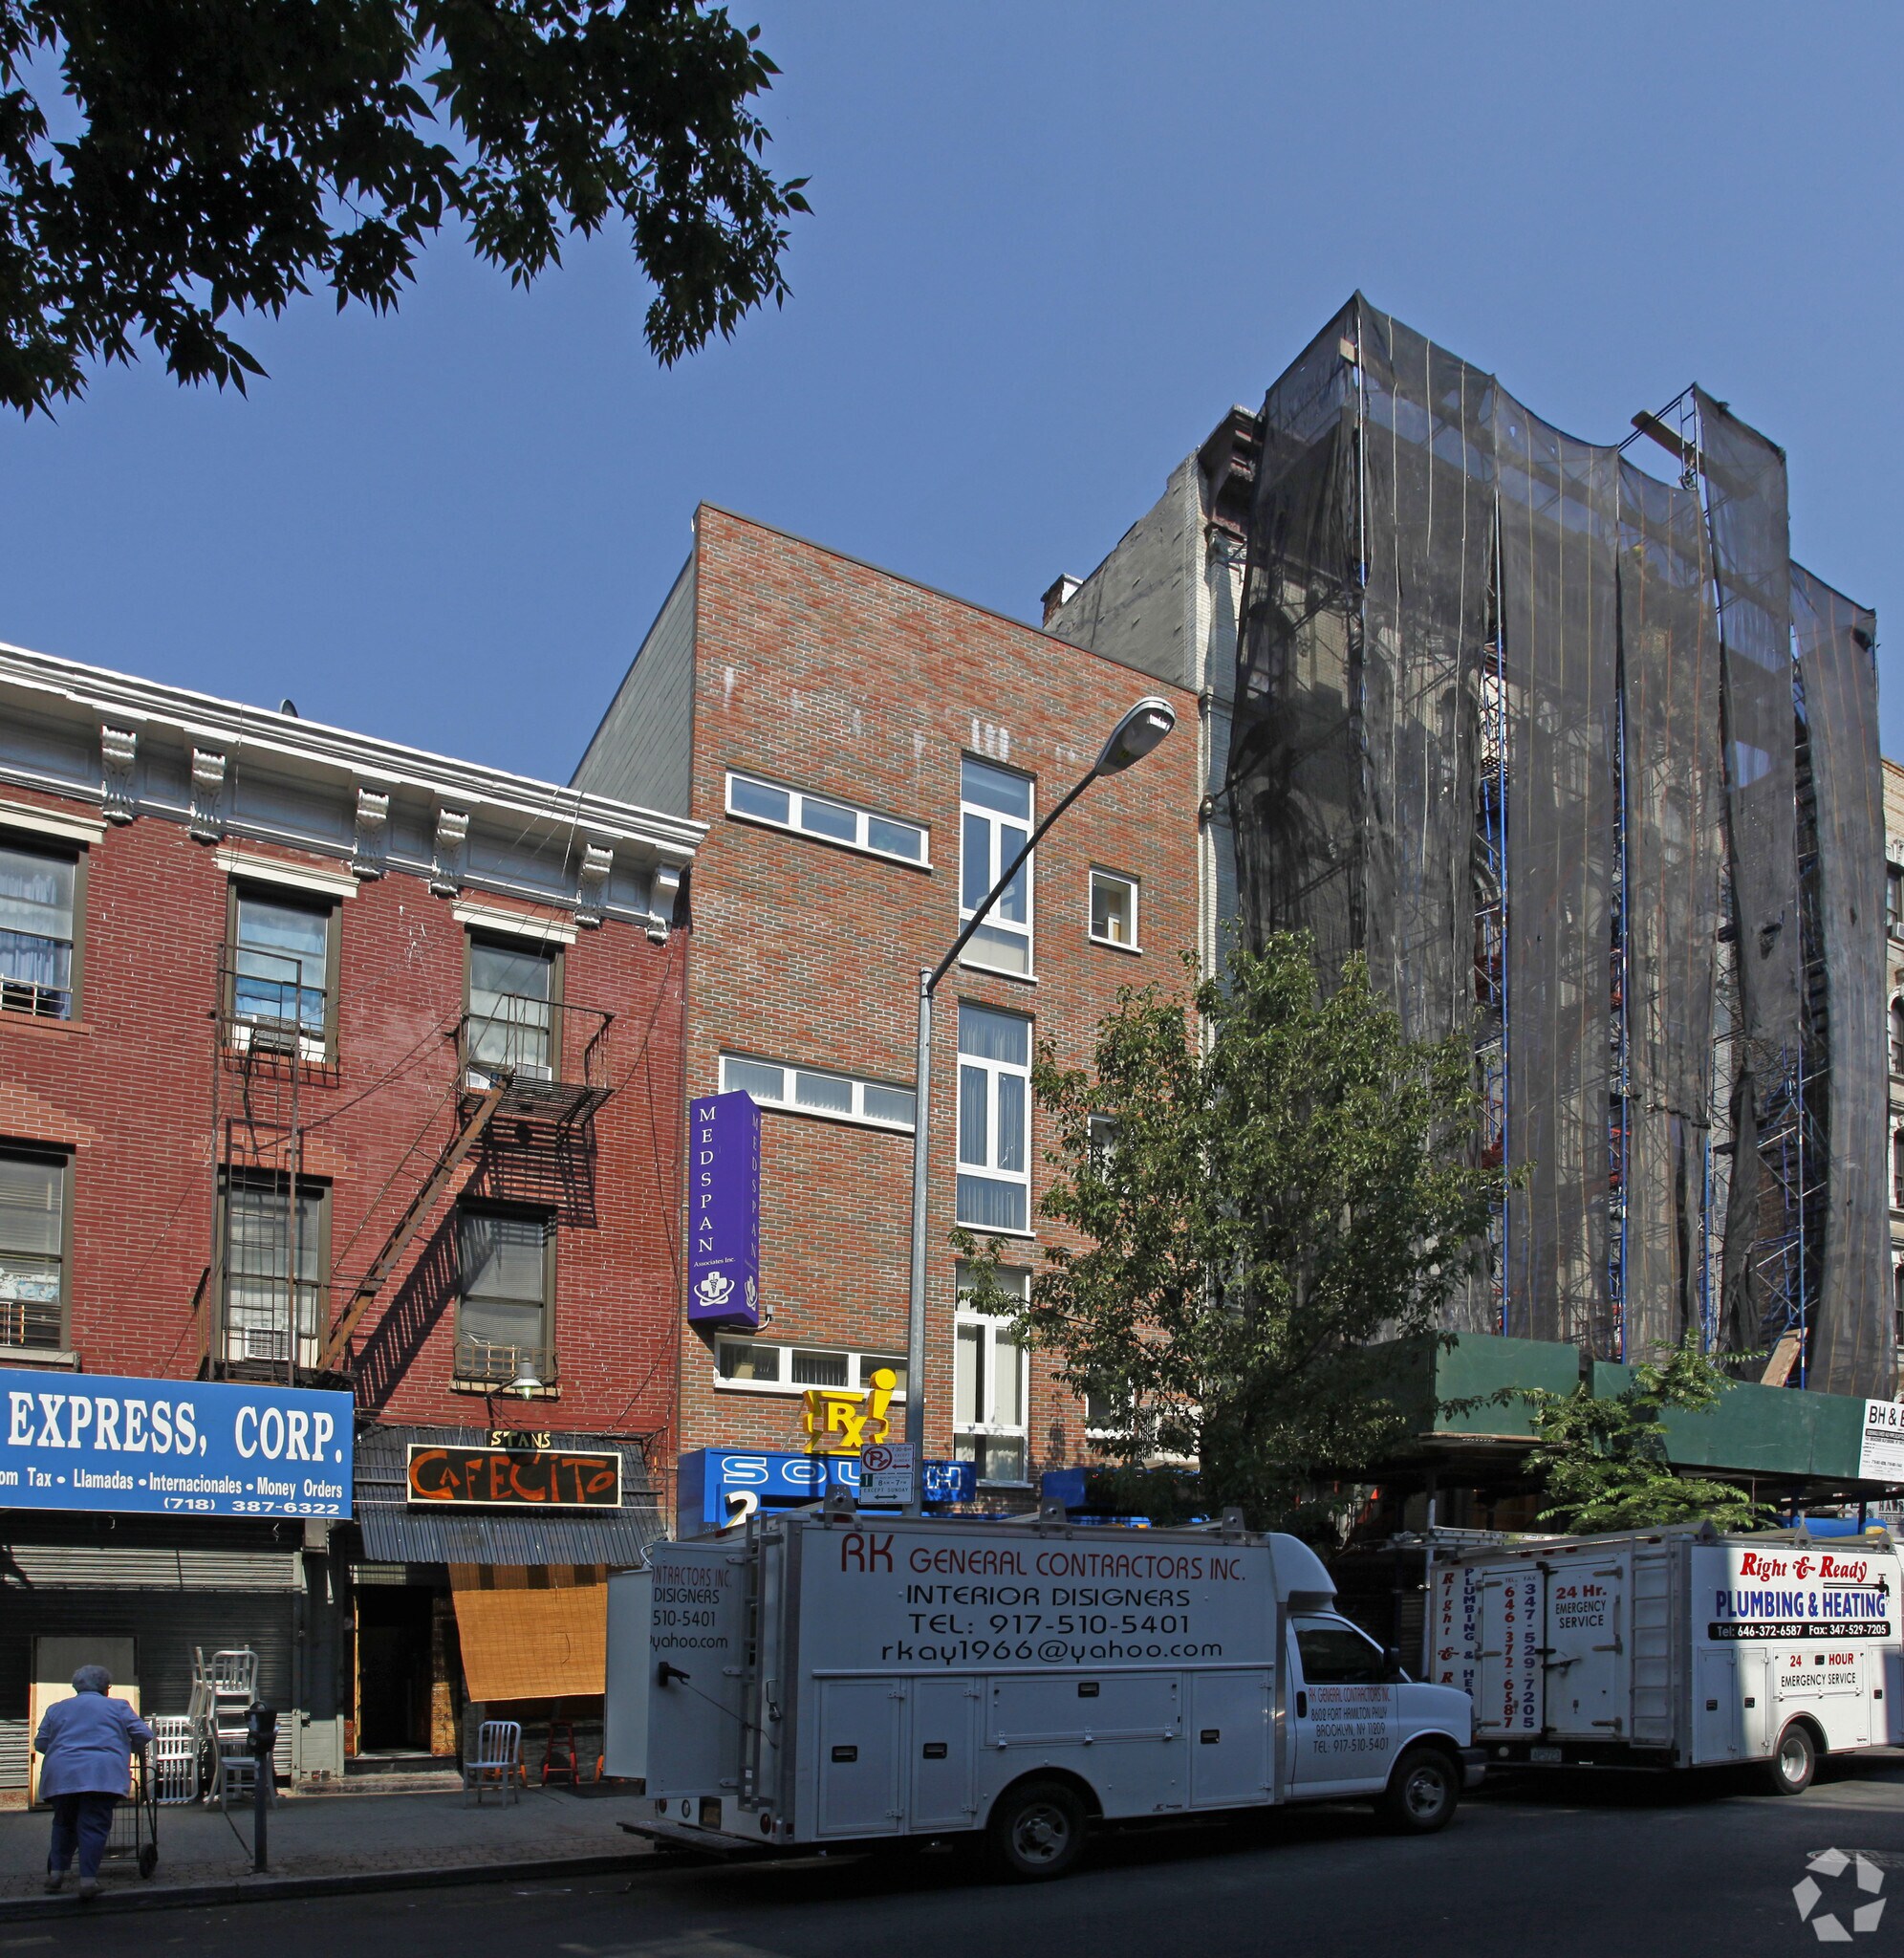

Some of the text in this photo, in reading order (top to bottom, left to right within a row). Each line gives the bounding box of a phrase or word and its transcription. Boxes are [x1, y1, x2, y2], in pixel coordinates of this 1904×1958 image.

[699, 1106, 716, 1252] MEDSPAN
[693, 1259, 724, 1268] Associates
[1869, 1405, 1886, 1425] BH
[1889, 1408, 1896, 1425] &
[8, 1391, 343, 1464] EXPRESS, CORP.
[490, 1430, 552, 1448] STANS
[27, 1467, 52, 1488] Tax
[74, 1468, 134, 1490] Llamadas
[149, 1471, 242, 1495] Internacionales
[257, 1476, 296, 1500] Money
[303, 1478, 343, 1499] Orders
[163, 1497, 340, 1515] (718) 387-6322
[841, 1533, 1245, 1580] RK GENERAL CONTRACTORS INC.
[1740, 1553, 1867, 1583] Right & Ready
[715, 1569, 732, 1587] INC.
[655, 1587, 720, 1604] DISIGNERS
[907, 1585, 1190, 1606] INTERIOR DISIGNERS
[1556, 1584, 1607, 1599] 24 Hr.
[1441, 1573, 1454, 1635] Right
[1463, 1568, 1475, 1641] PLUMBING
[1555, 1599, 1606, 1615] EMERGENCY
[1716, 1590, 1886, 1618] PLUMBING & HEATING
[653, 1610, 716, 1626] 510-5401
[908, 1613, 1188, 1635] TEL: 917-510-5401
[1559, 1615, 1604, 1628] SERVICE
[1718, 1623, 1887, 1637] Tel: 646-372-6587 Fax: 347-529-7205
[881, 1640, 1222, 1666] rkay1966@yahoo.com
[1504, 1586, 1515, 1728] 646-372-6587
[1523, 1583, 1536, 1728] 347-529-7205
[1789, 1653, 1854, 1667] 24 HOUR
[1781, 1672, 1856, 1687] EMERGENCY SERVICE
[1318, 1687, 1342, 1703] GENERAL
[1343, 1686, 1381, 1702] CONTRACTORS
[1311, 1708, 1327, 1721] 8602
[1328, 1708, 1342, 1721] FORT
[1343, 1707, 1371, 1720] HAMILTON
[1316, 1722, 1386, 1737] BROOKLYN, NY 11209
[1313, 1737, 1389, 1753] TEL: 917-510-5401
